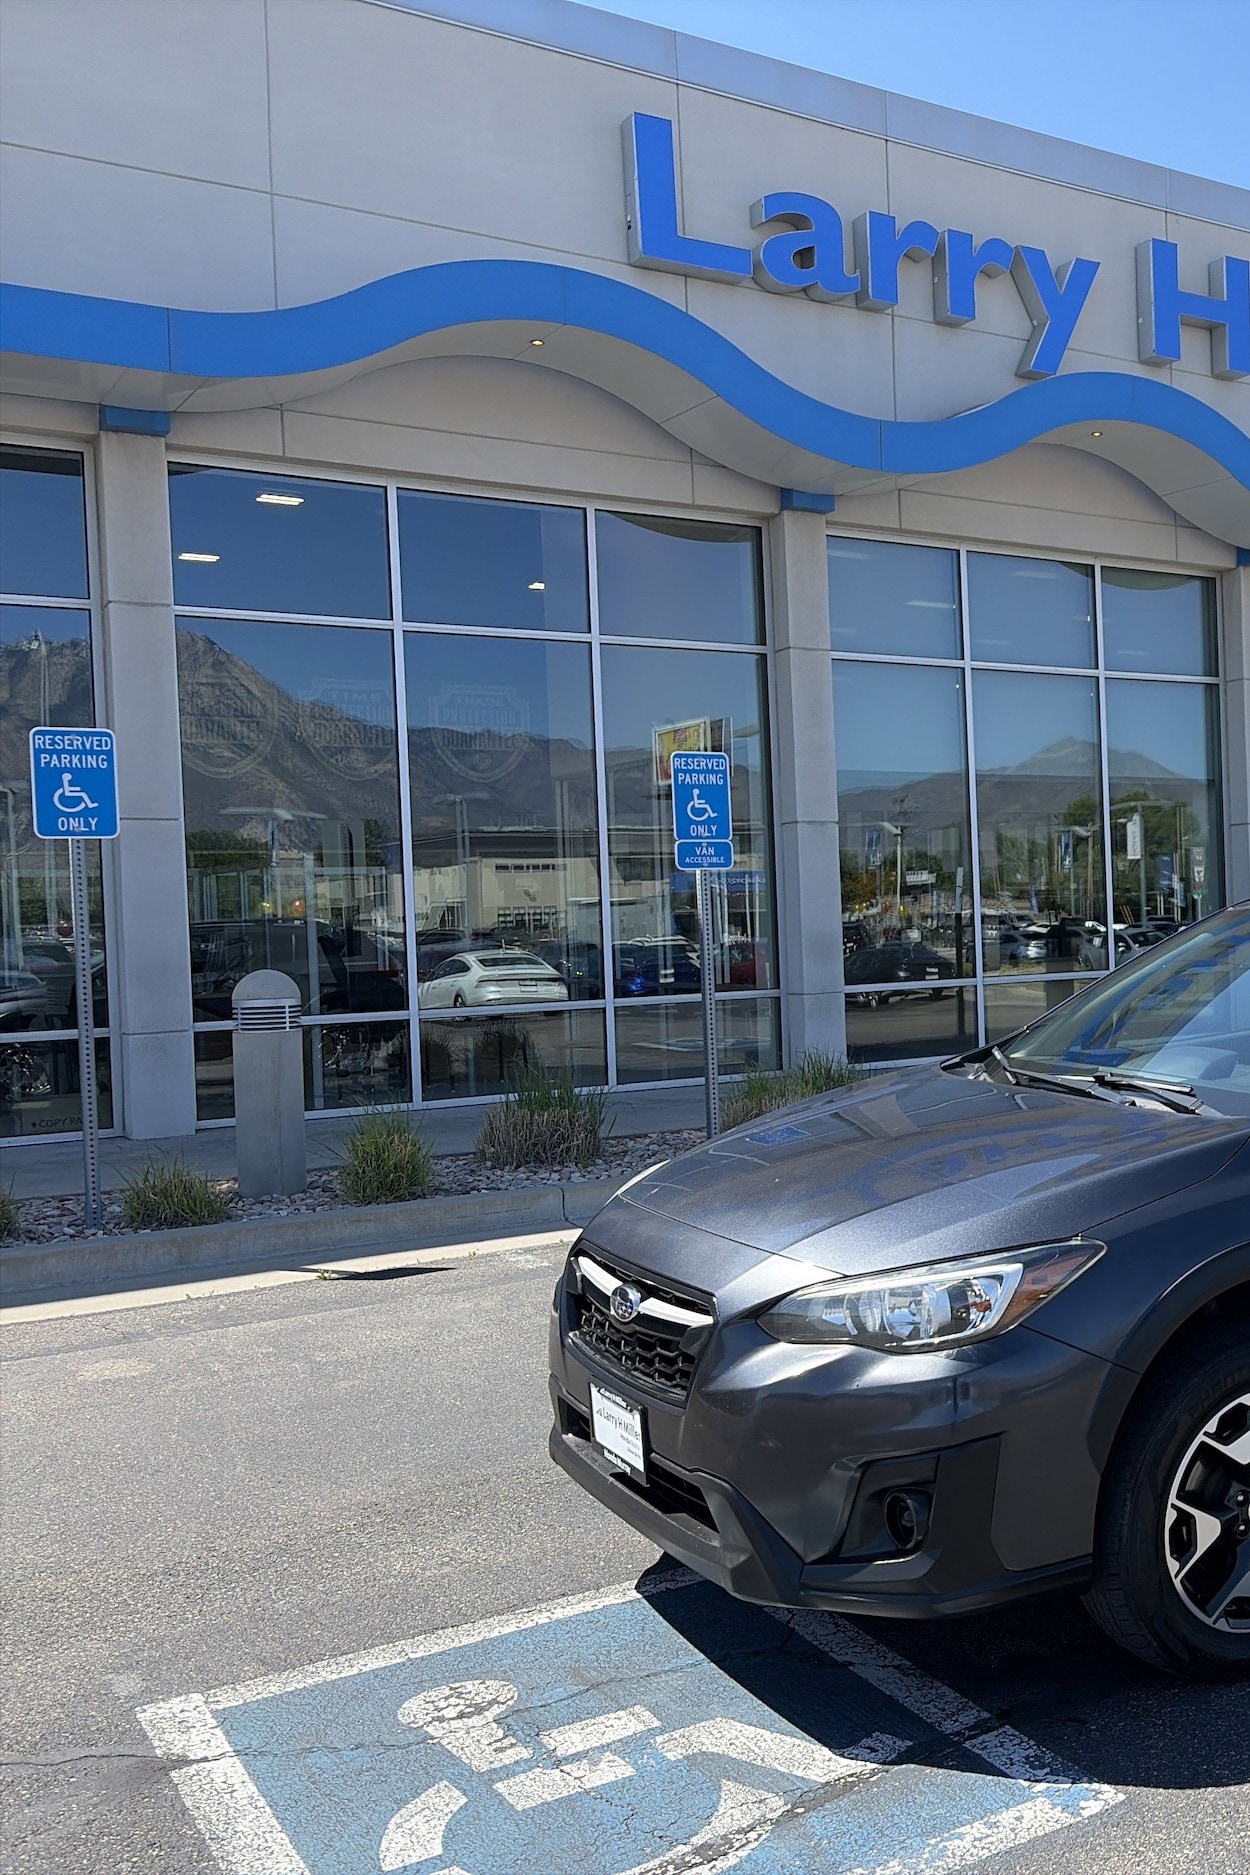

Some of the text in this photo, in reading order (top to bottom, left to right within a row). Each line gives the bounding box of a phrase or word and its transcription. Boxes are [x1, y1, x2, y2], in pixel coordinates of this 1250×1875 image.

[626, 112, 1100, 378] Larry
[34, 735, 111, 750] RESERVED
[40, 754, 107, 769] PARKING
[674, 758, 726, 770] RESERVED
[678, 773, 724, 785] PARKING
[58, 817, 98, 831] ONLY
[690, 825, 717, 836] ONLY
[695, 846, 715, 856] VAN
[39, 1117, 67, 1128] COPY
[603, 1407, 618, 1430] Larry
[623, 1419, 641, 1440] Miller
